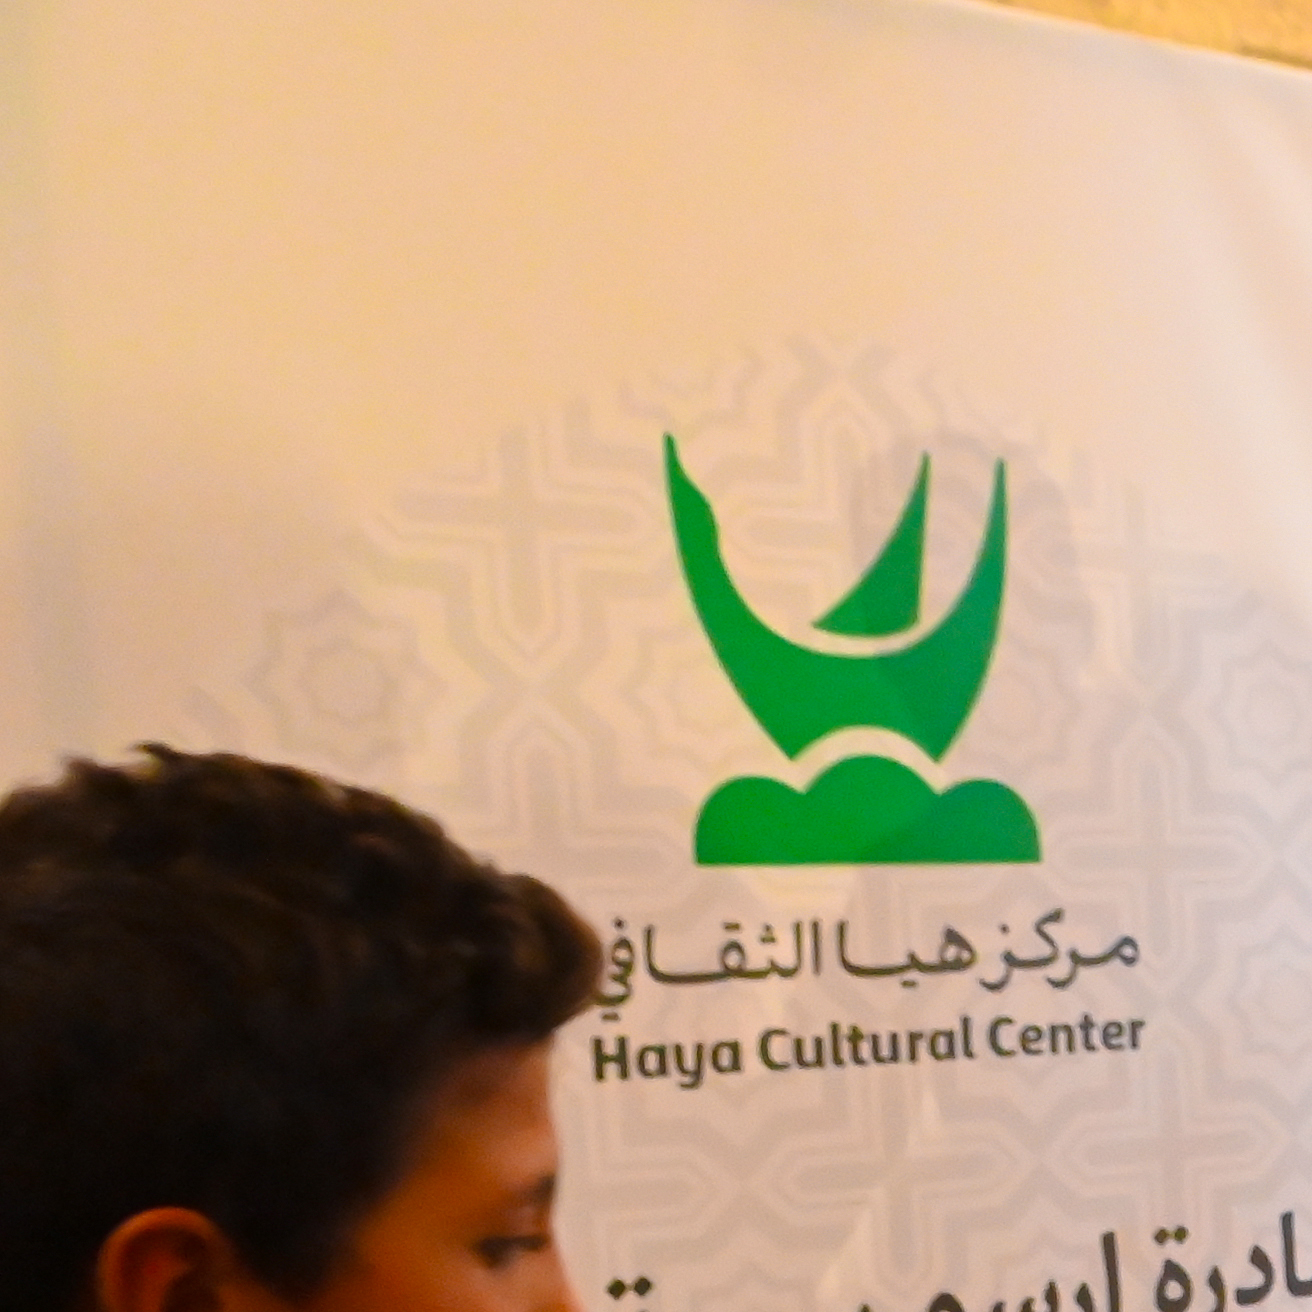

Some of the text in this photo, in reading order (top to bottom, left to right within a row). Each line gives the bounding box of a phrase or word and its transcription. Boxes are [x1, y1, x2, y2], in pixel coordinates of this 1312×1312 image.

[598, 908, 1140, 1021] مركز هيا الثقافي
[592, 1011, 1146, 1089] Haya Cultural Center
